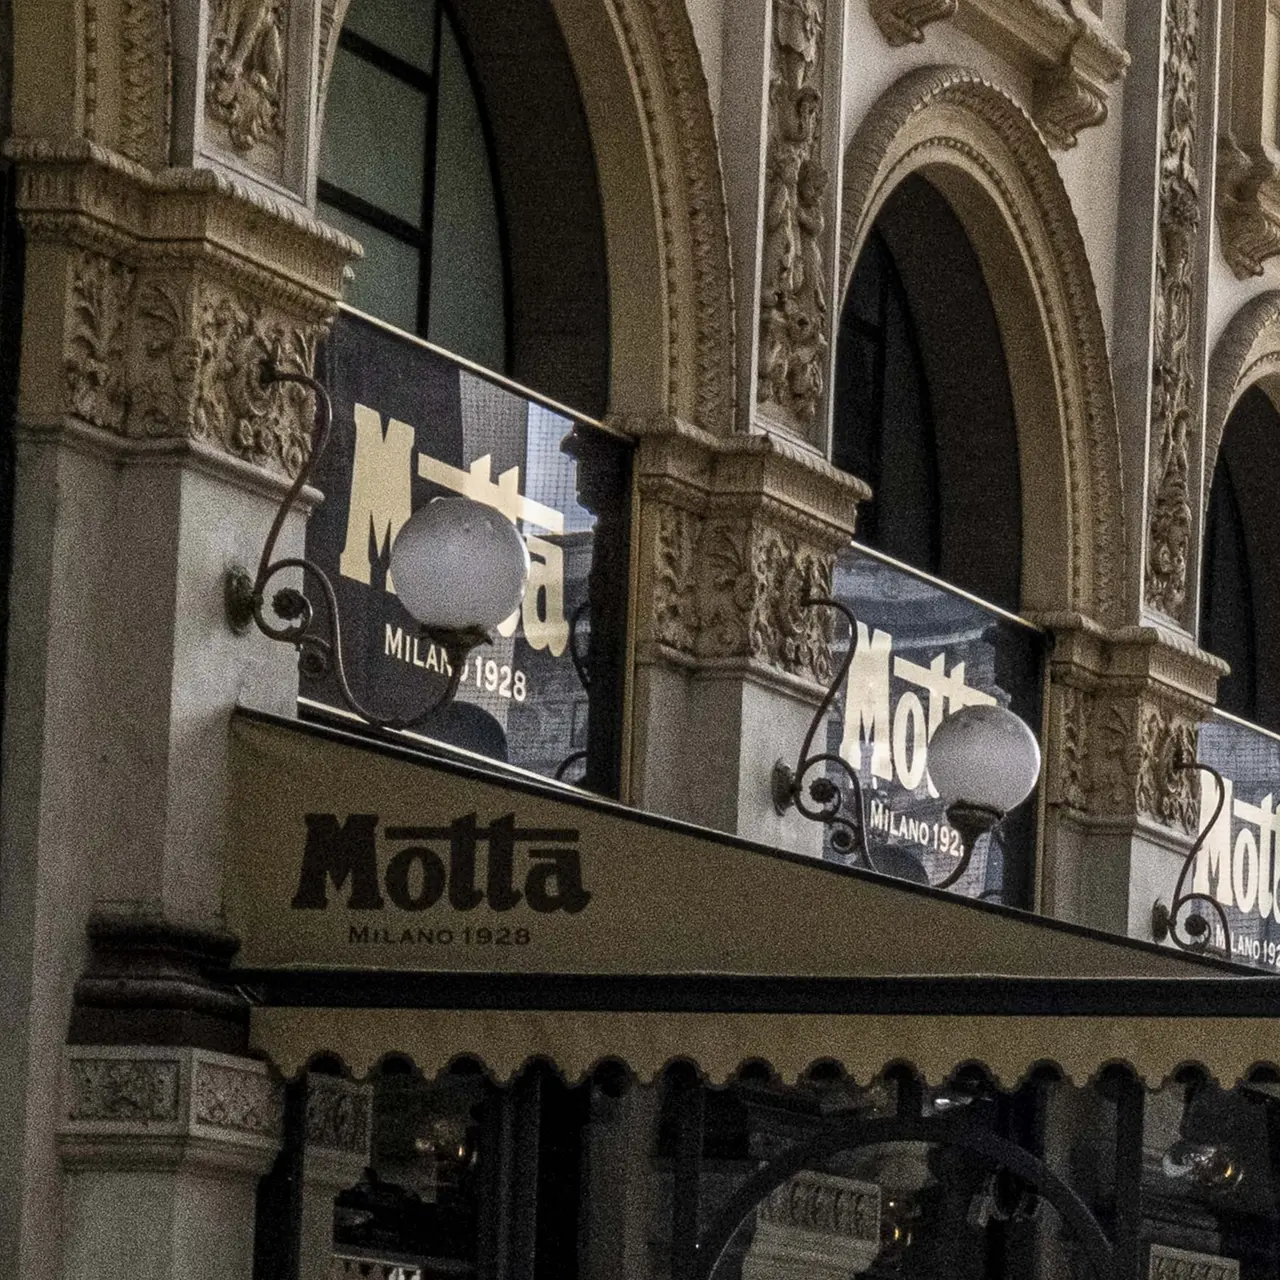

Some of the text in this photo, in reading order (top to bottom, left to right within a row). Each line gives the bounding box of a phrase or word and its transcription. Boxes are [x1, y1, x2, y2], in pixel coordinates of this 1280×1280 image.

[475, 655, 527, 702] 1928
[870, 800, 964, 858] MILANO 192
[290, 811, 592, 914] Motta
[350, 924, 531, 946] MILANO 1928
[1215, 924, 1260, 961] MLANO
